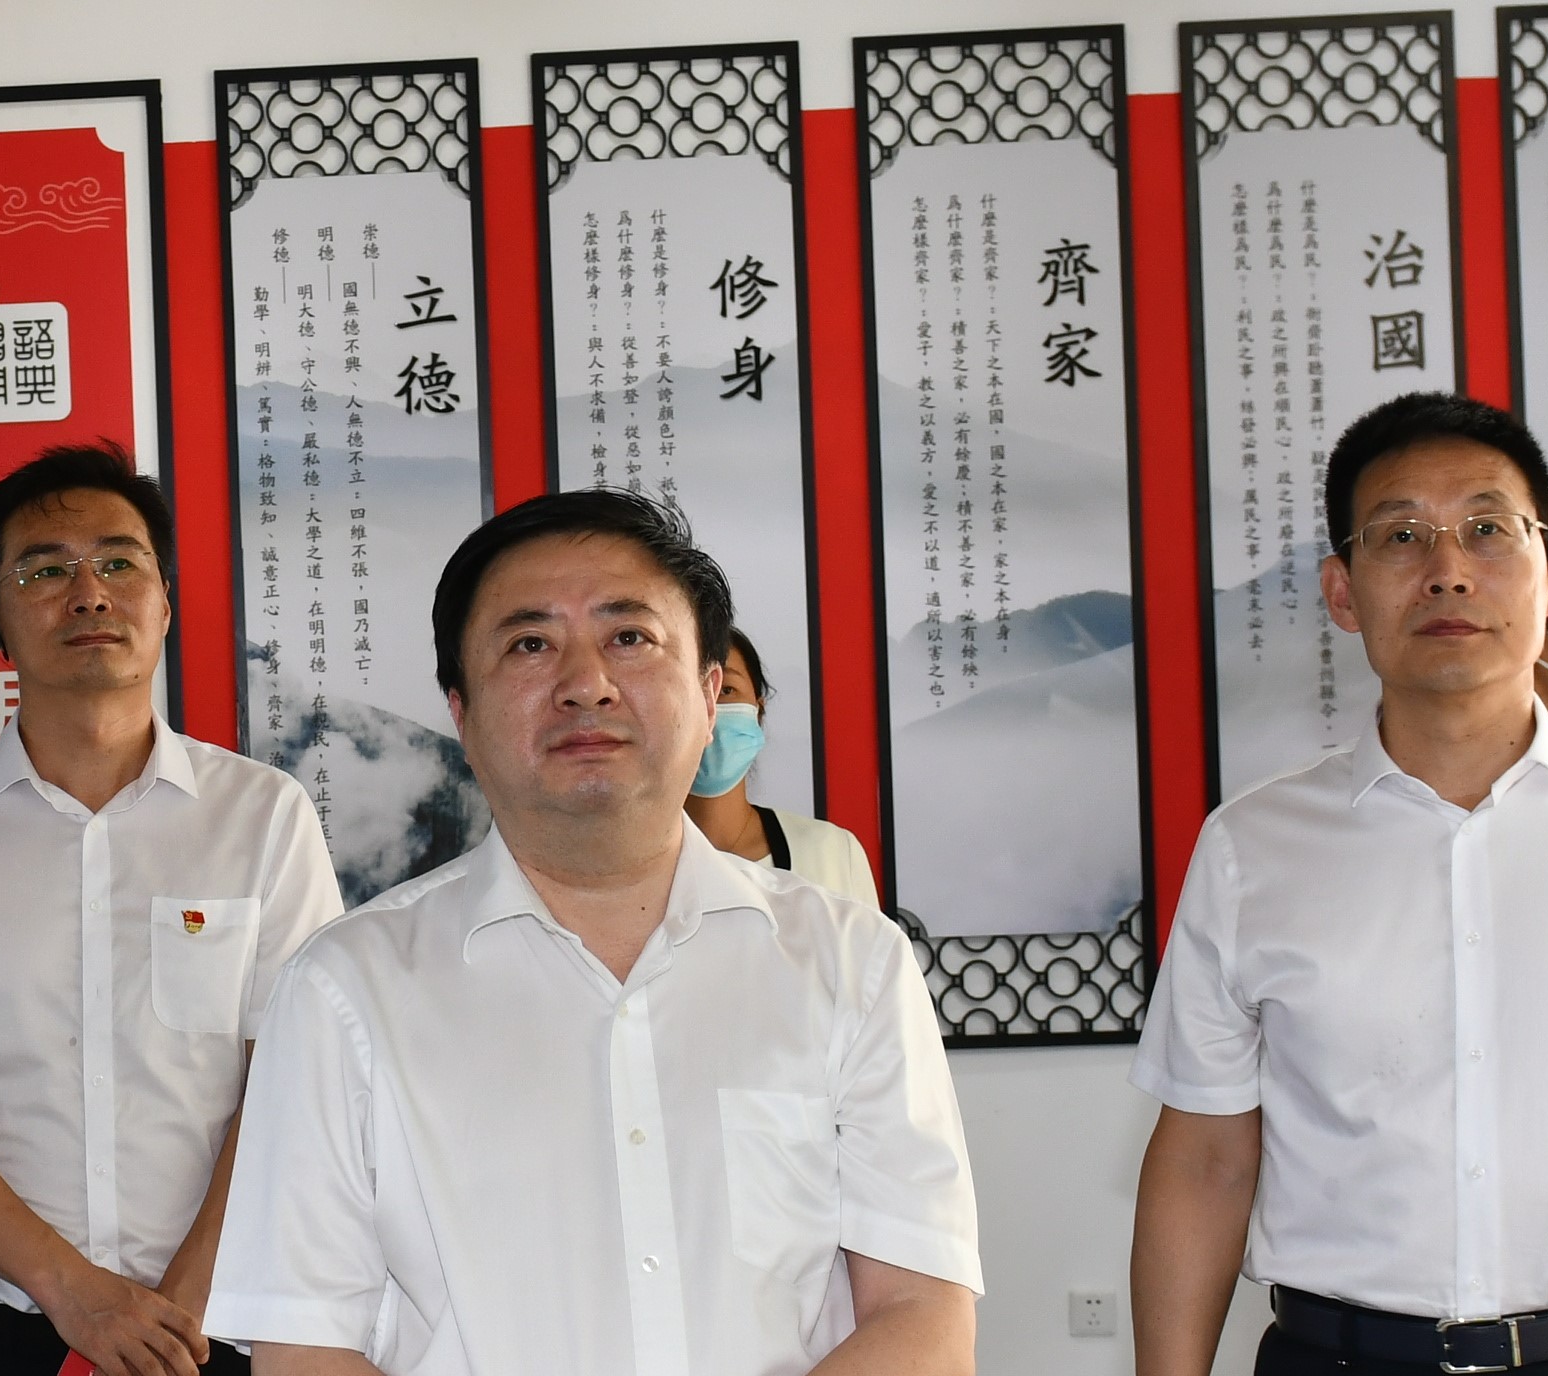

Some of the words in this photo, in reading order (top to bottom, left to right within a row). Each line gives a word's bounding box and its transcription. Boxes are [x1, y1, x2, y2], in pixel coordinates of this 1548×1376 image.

[394, 275, 460, 415] 立德
[709, 255, 779, 401] 修身
[1037, 238, 1102, 387] 齊家
[1363, 229, 1425, 371] 治國
